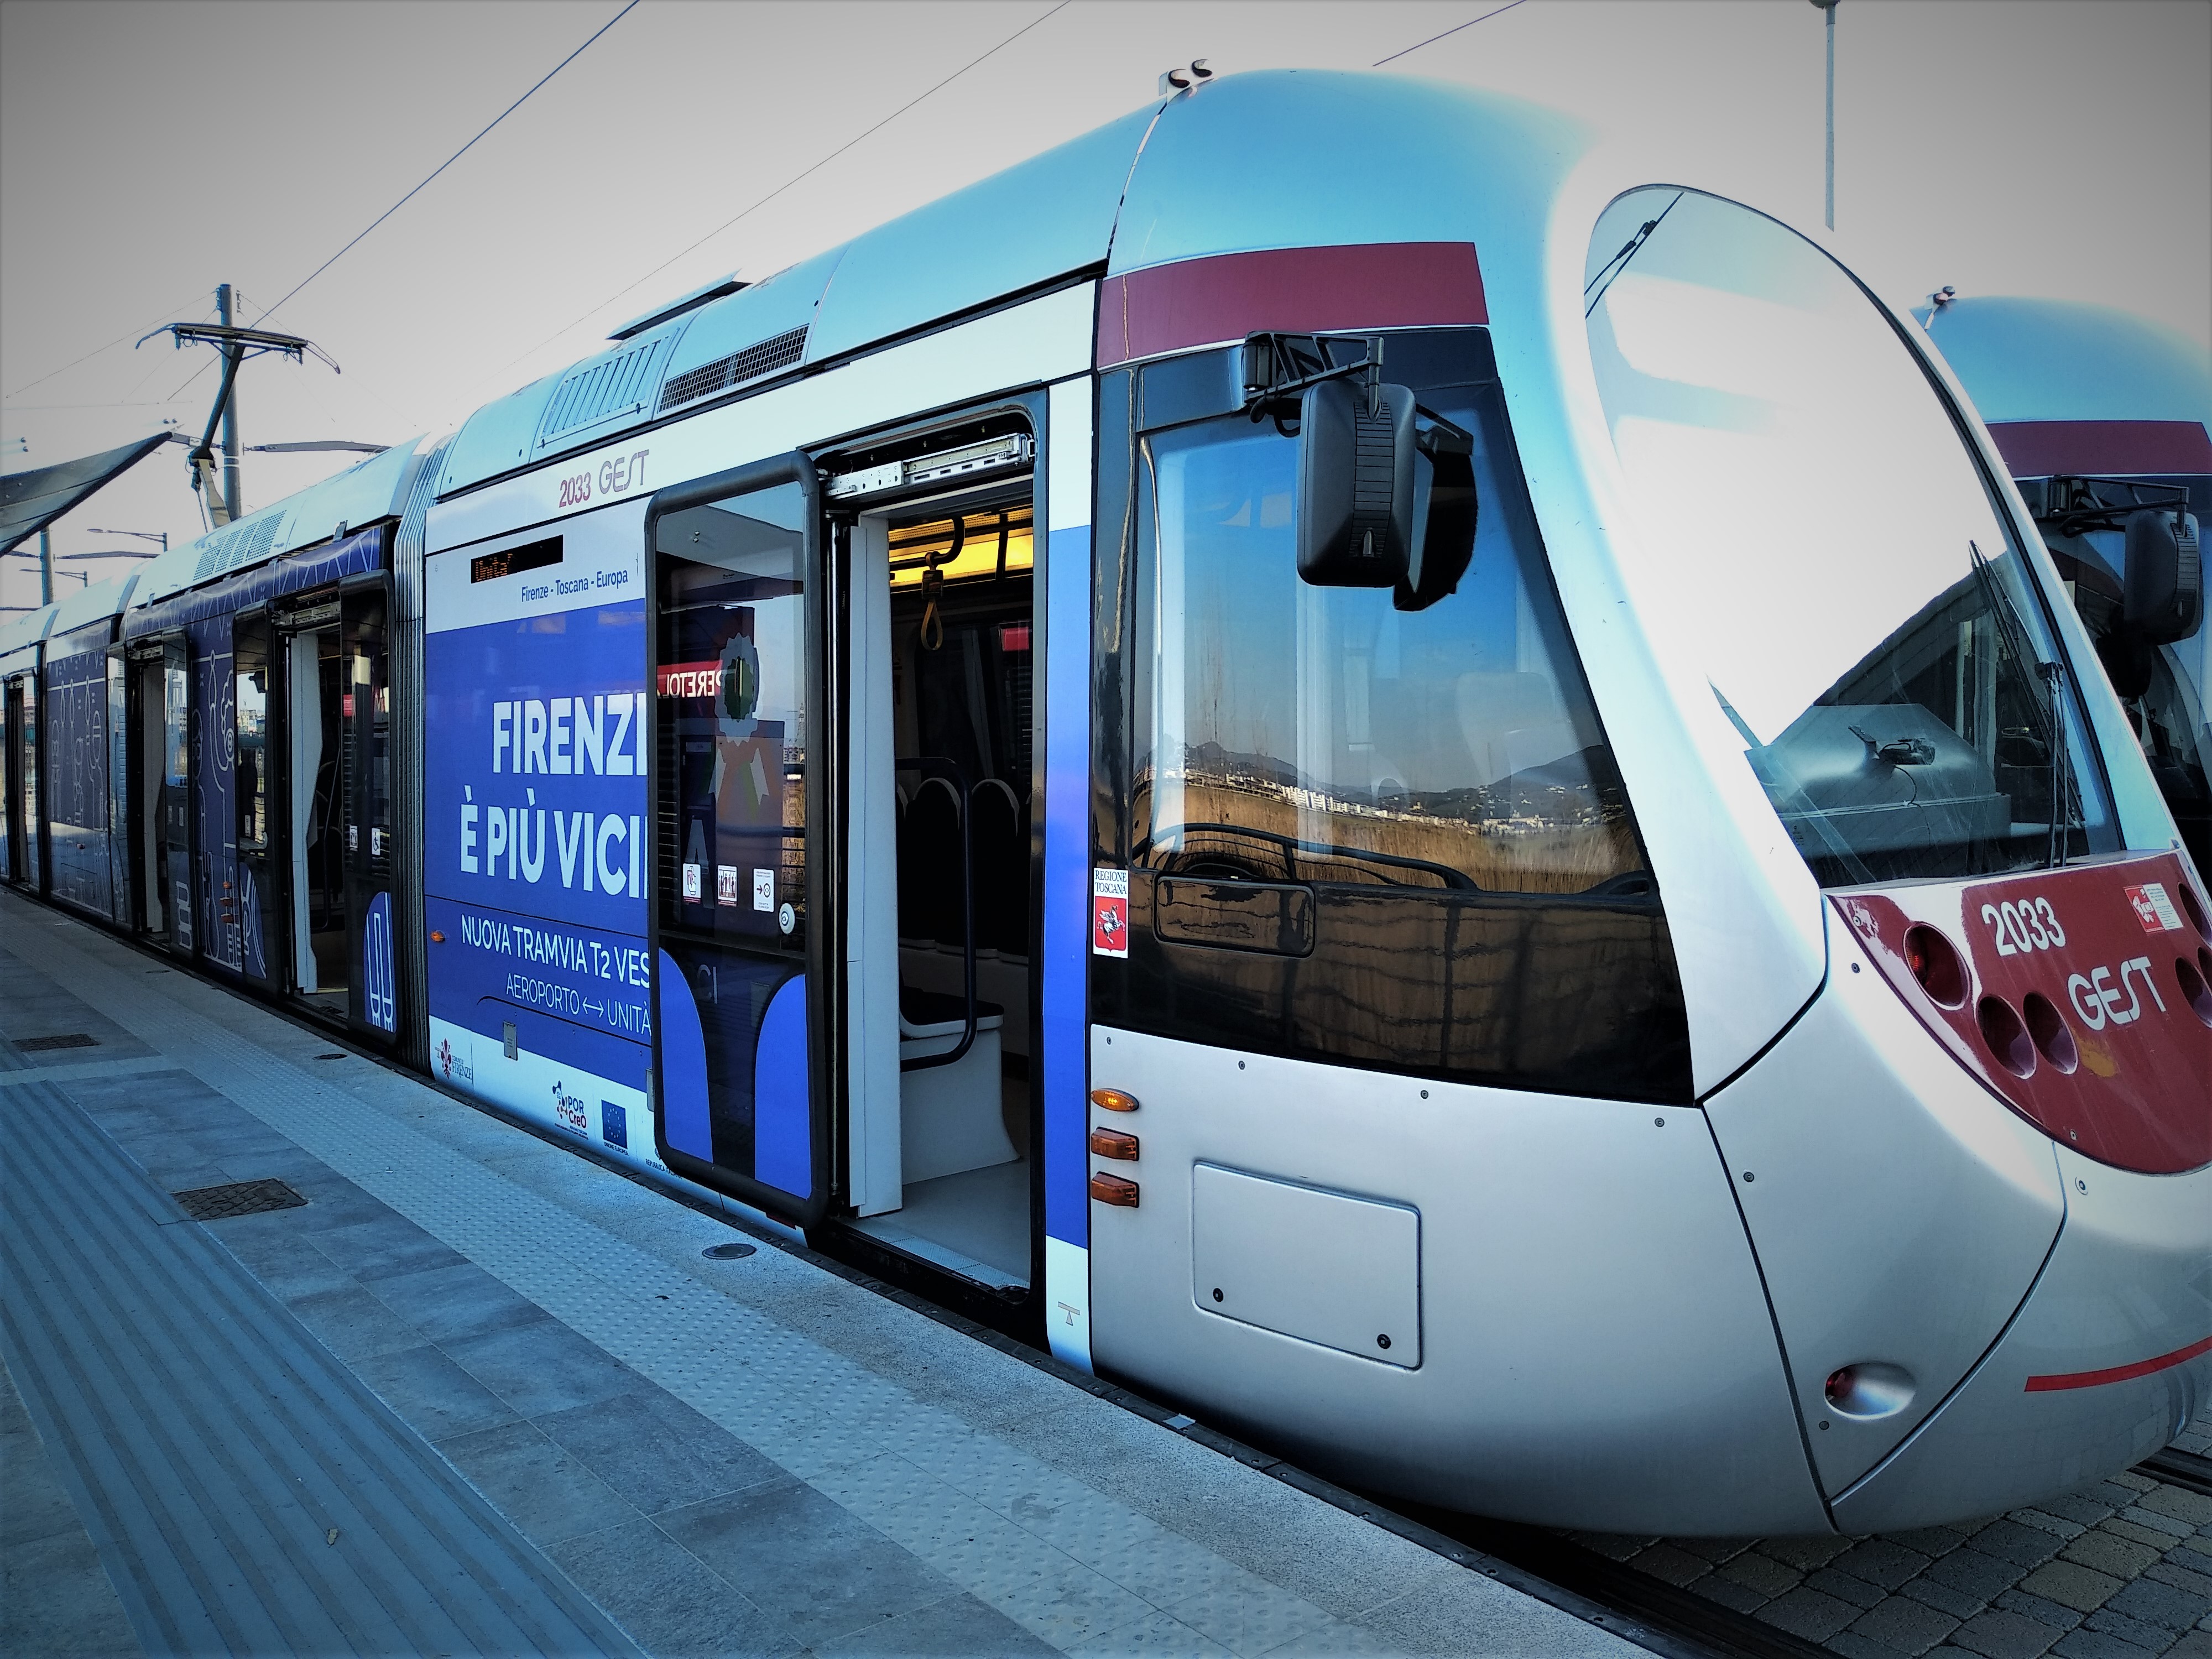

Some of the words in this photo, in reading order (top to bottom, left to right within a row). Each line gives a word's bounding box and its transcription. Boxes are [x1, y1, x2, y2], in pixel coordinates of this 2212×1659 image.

[559, 472, 591, 508] 2033
[599, 449, 649, 494] GEST
[521, 586, 549, 602] Firenze
[555, 578, 589, 596] Toscana
[597, 570, 628, 589] Europa
[460, 785, 478, 874] È
[487, 787, 546, 884] PIÙ
[1095, 870, 1127, 882] REGIONE
[1095, 882, 1127, 894] TOSCANA
[1981, 897, 2066, 956] 2033
[461, 914, 512, 956] NUOVA
[512, 925, 588, 974] TRAMVIA
[589, 941, 611, 979] T2
[506, 972, 580, 1015] AEROPORTO
[2067, 956, 2167, 1030] GEST
[452, 1061, 472, 1080] FIRENZE
[568, 1095, 584, 1114] POR
[568, 1109, 587, 1129] CreO
